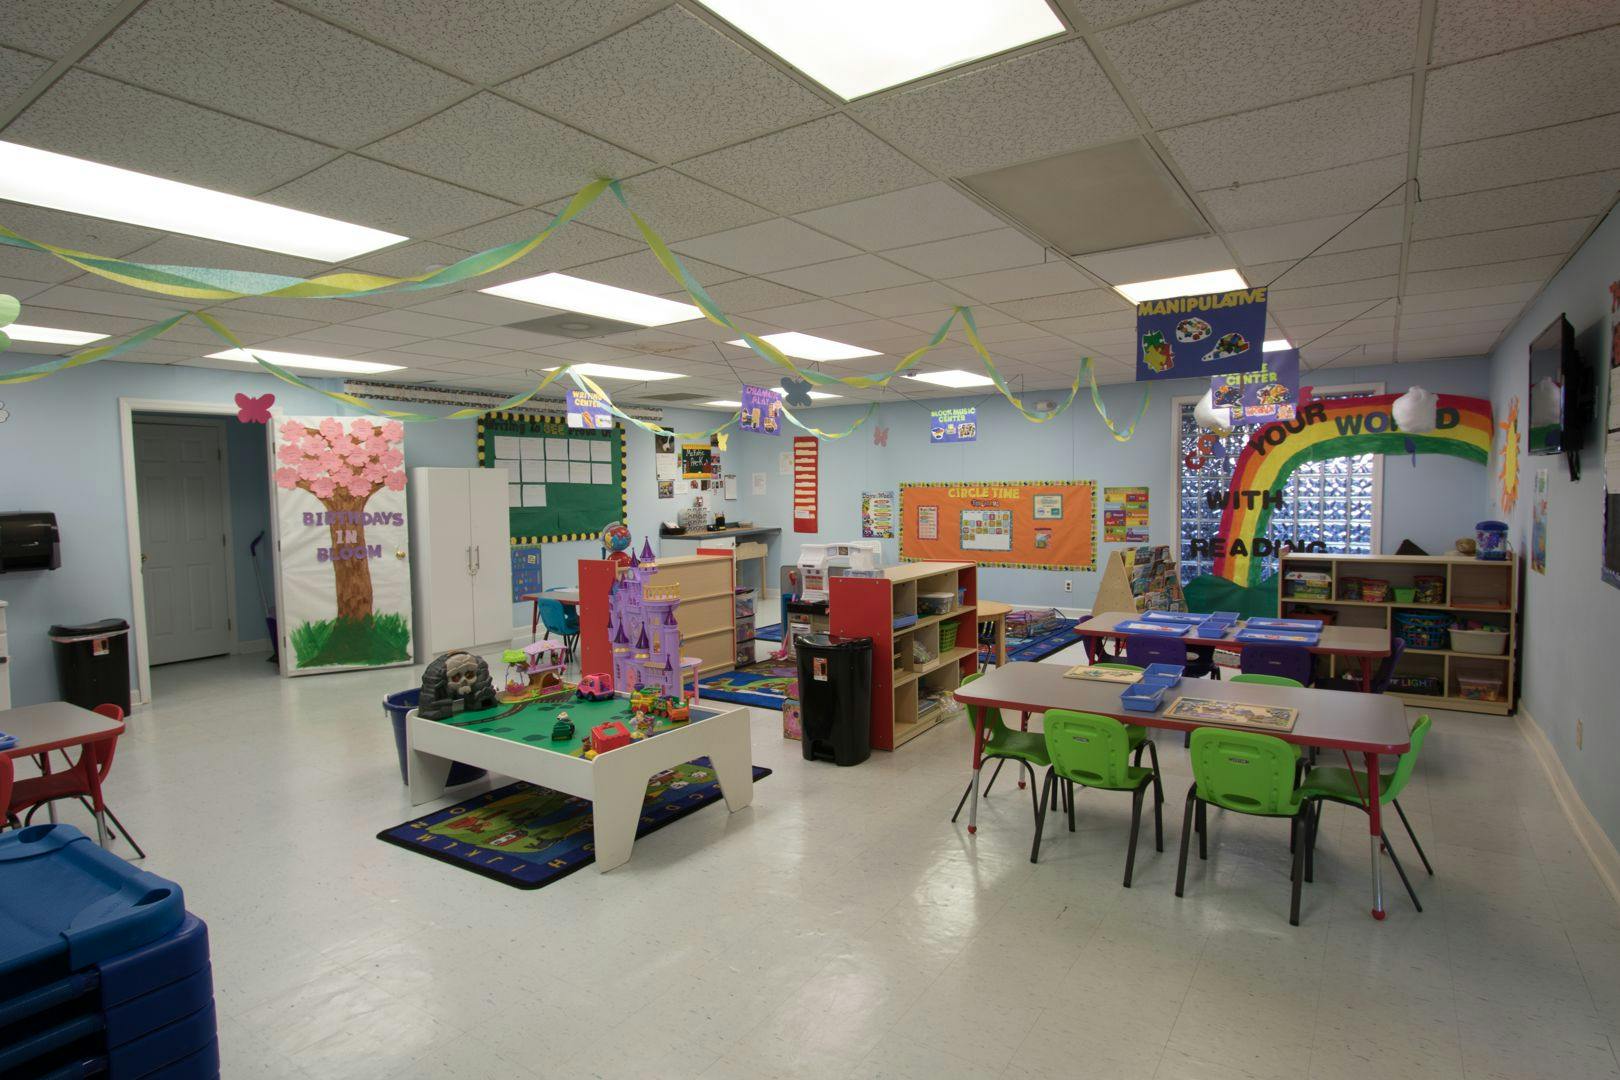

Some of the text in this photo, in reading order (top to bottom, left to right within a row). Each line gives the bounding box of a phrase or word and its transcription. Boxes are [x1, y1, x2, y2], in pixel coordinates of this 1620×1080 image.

[1138, 288, 1267, 316] MANIPULATIVE
[1226, 372, 1277, 386] CENTER
[1249, 403, 1328, 456] YOUR
[1334, 407, 1460, 435] WOD
[948, 488, 1020, 499] CIRCLE TIME
[1206, 490, 1285, 511] WITH
[302, 511, 404, 527] BIRTHDAYS
[335, 529, 358, 544] IN
[317, 544, 382, 562] BLOOM
[1190, 538, 1328, 558] READING
